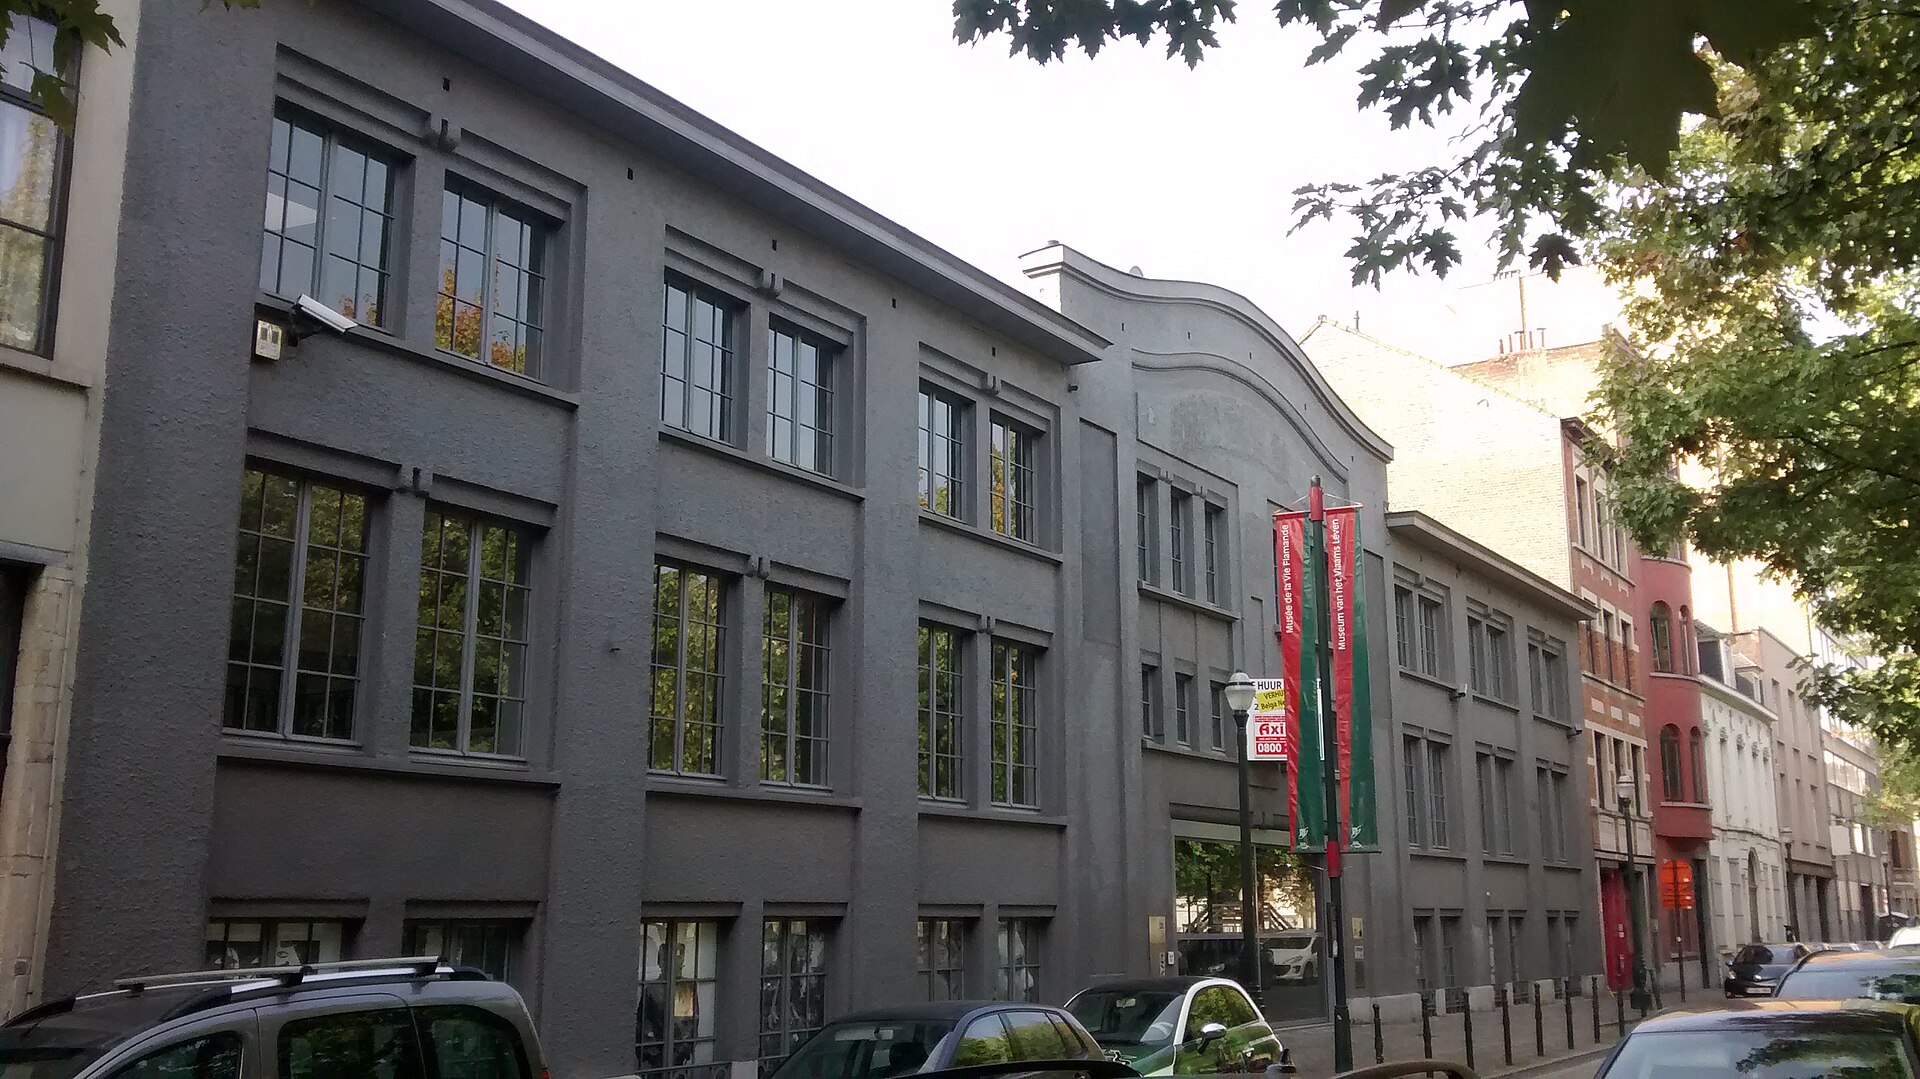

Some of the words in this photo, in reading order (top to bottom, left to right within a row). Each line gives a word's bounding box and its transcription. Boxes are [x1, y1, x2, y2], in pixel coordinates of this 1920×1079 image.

[1332, 518, 1340, 544] Leven
[1282, 524, 1291, 566] Flamande
[1333, 545, 1342, 577] Vlaams
[1283, 582, 1292, 591] la
[1335, 577, 1343, 594] het
[1284, 592, 1293, 604] de
[1336, 595, 1344, 612] van
[1285, 605, 1294, 634] Musée
[1337, 612, 1346, 650] Museum
[1257, 681, 1282, 690] HUUR
[1260, 702, 1277, 710] Belga
[1257, 743, 1282, 753] 0800
